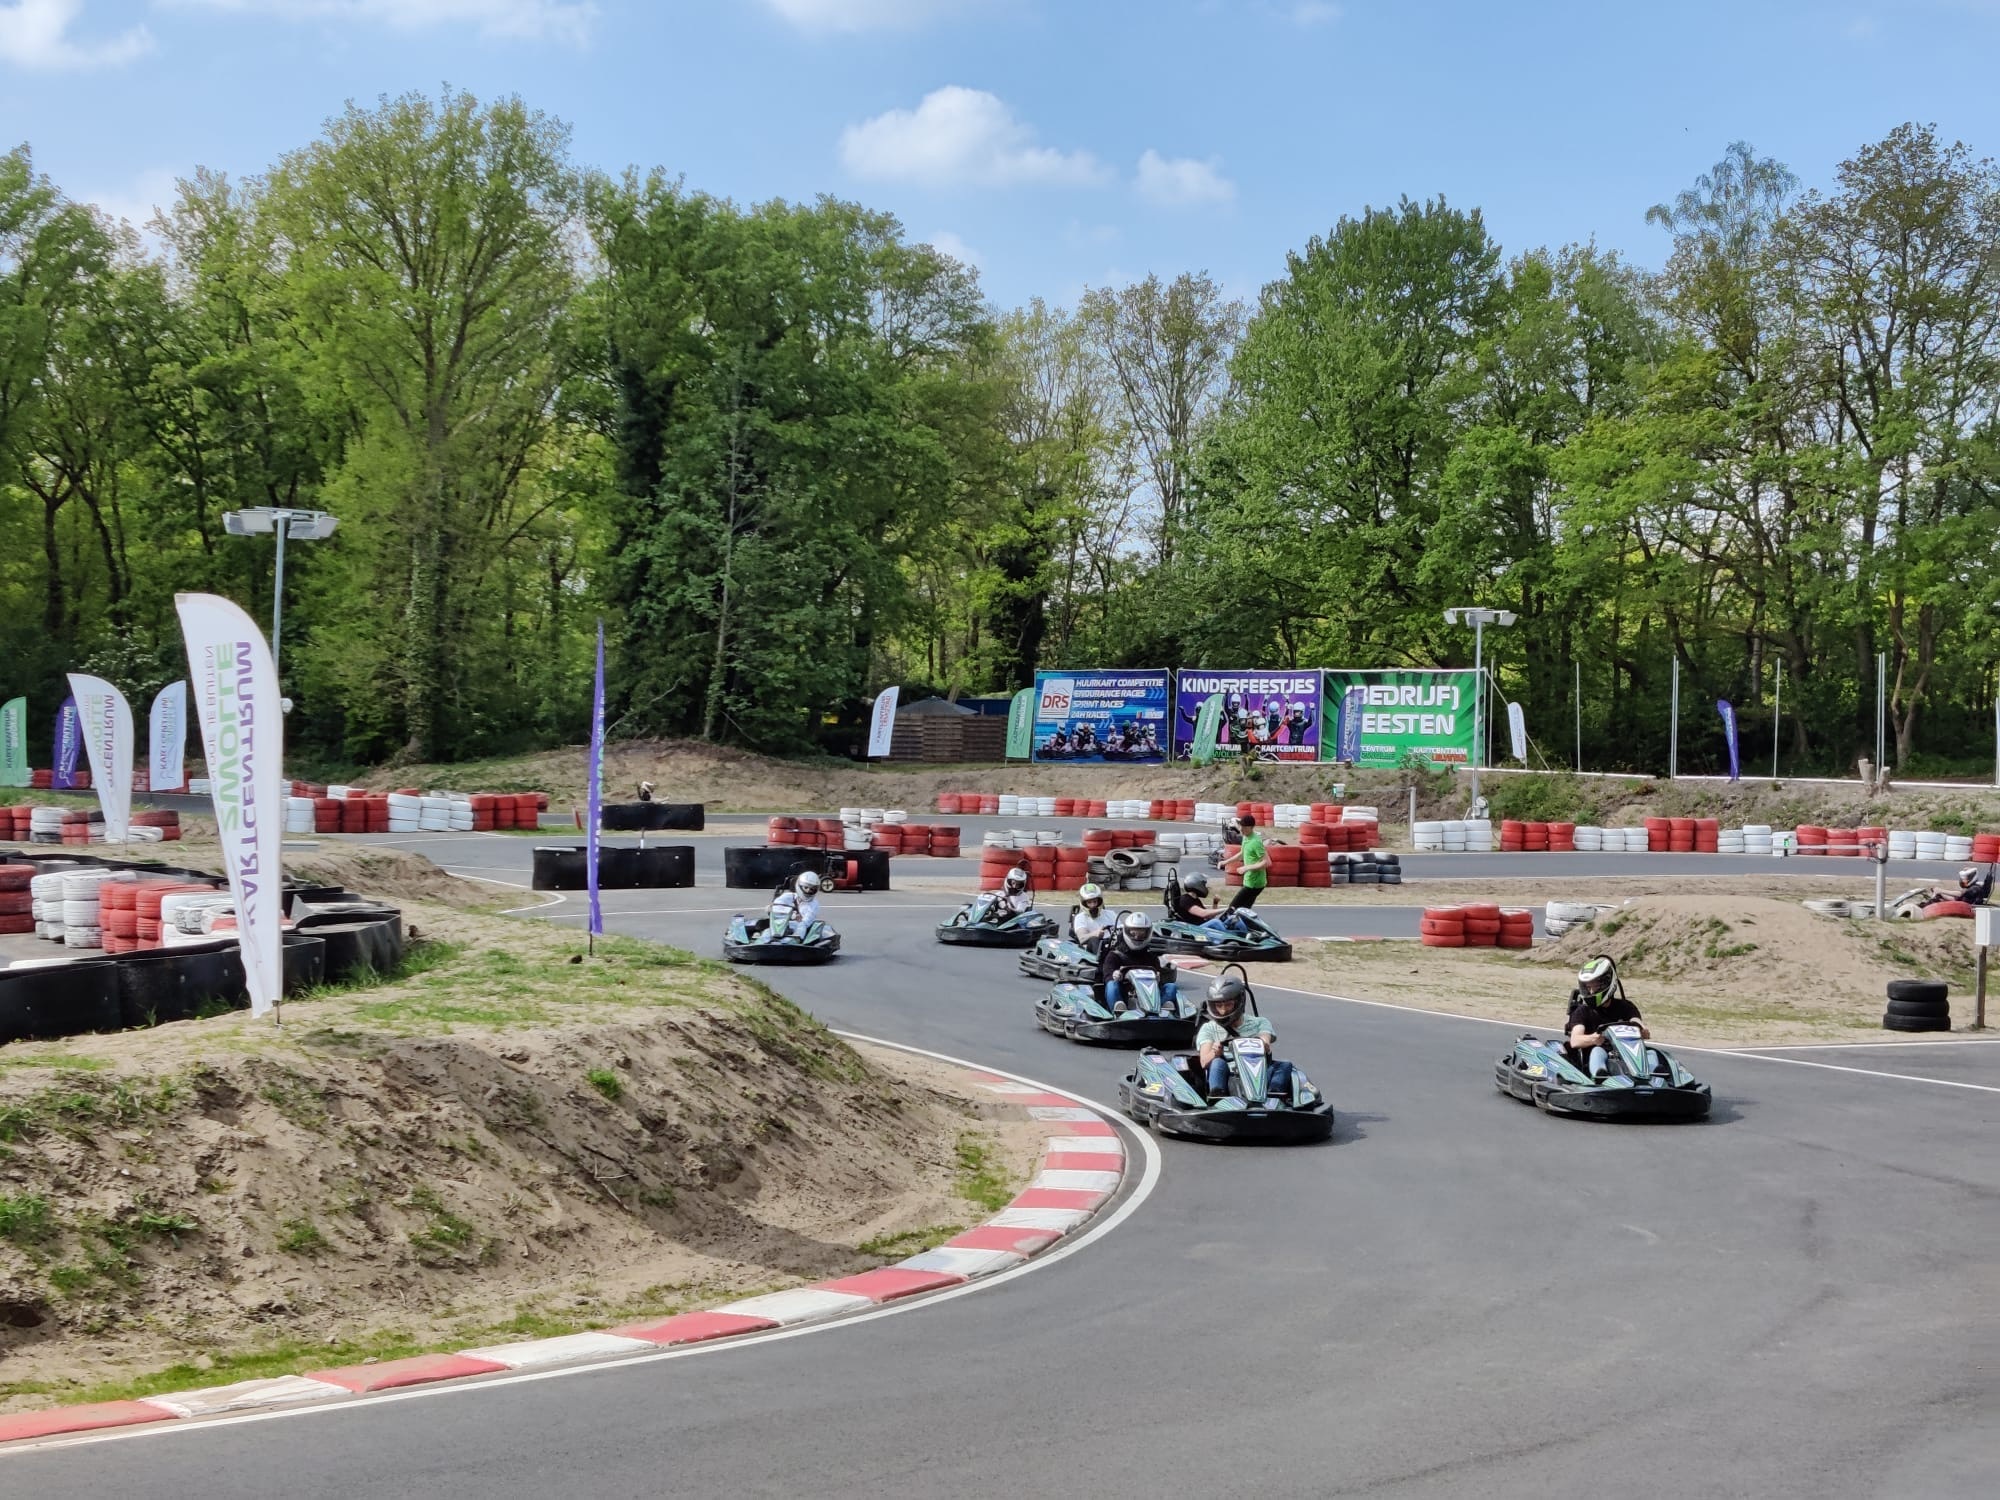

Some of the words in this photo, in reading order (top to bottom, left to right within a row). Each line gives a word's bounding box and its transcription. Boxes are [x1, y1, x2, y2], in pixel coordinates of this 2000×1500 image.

[1182, 678, 1316, 694] KINDERFEESTJES
[1073, 689, 1120, 698] ENDURANCE
[1121, 689, 1146, 697] RACES
[1041, 695, 1069, 709] DRS
[1071, 701, 1100, 709] SPRINT
[1086, 711, 1110, 719] RACES
[1362, 714, 1454, 735] EESTEN
[1261, 745, 1315, 753] KARTCENTRUM
[1238, 1039, 1262, 1049] 25
